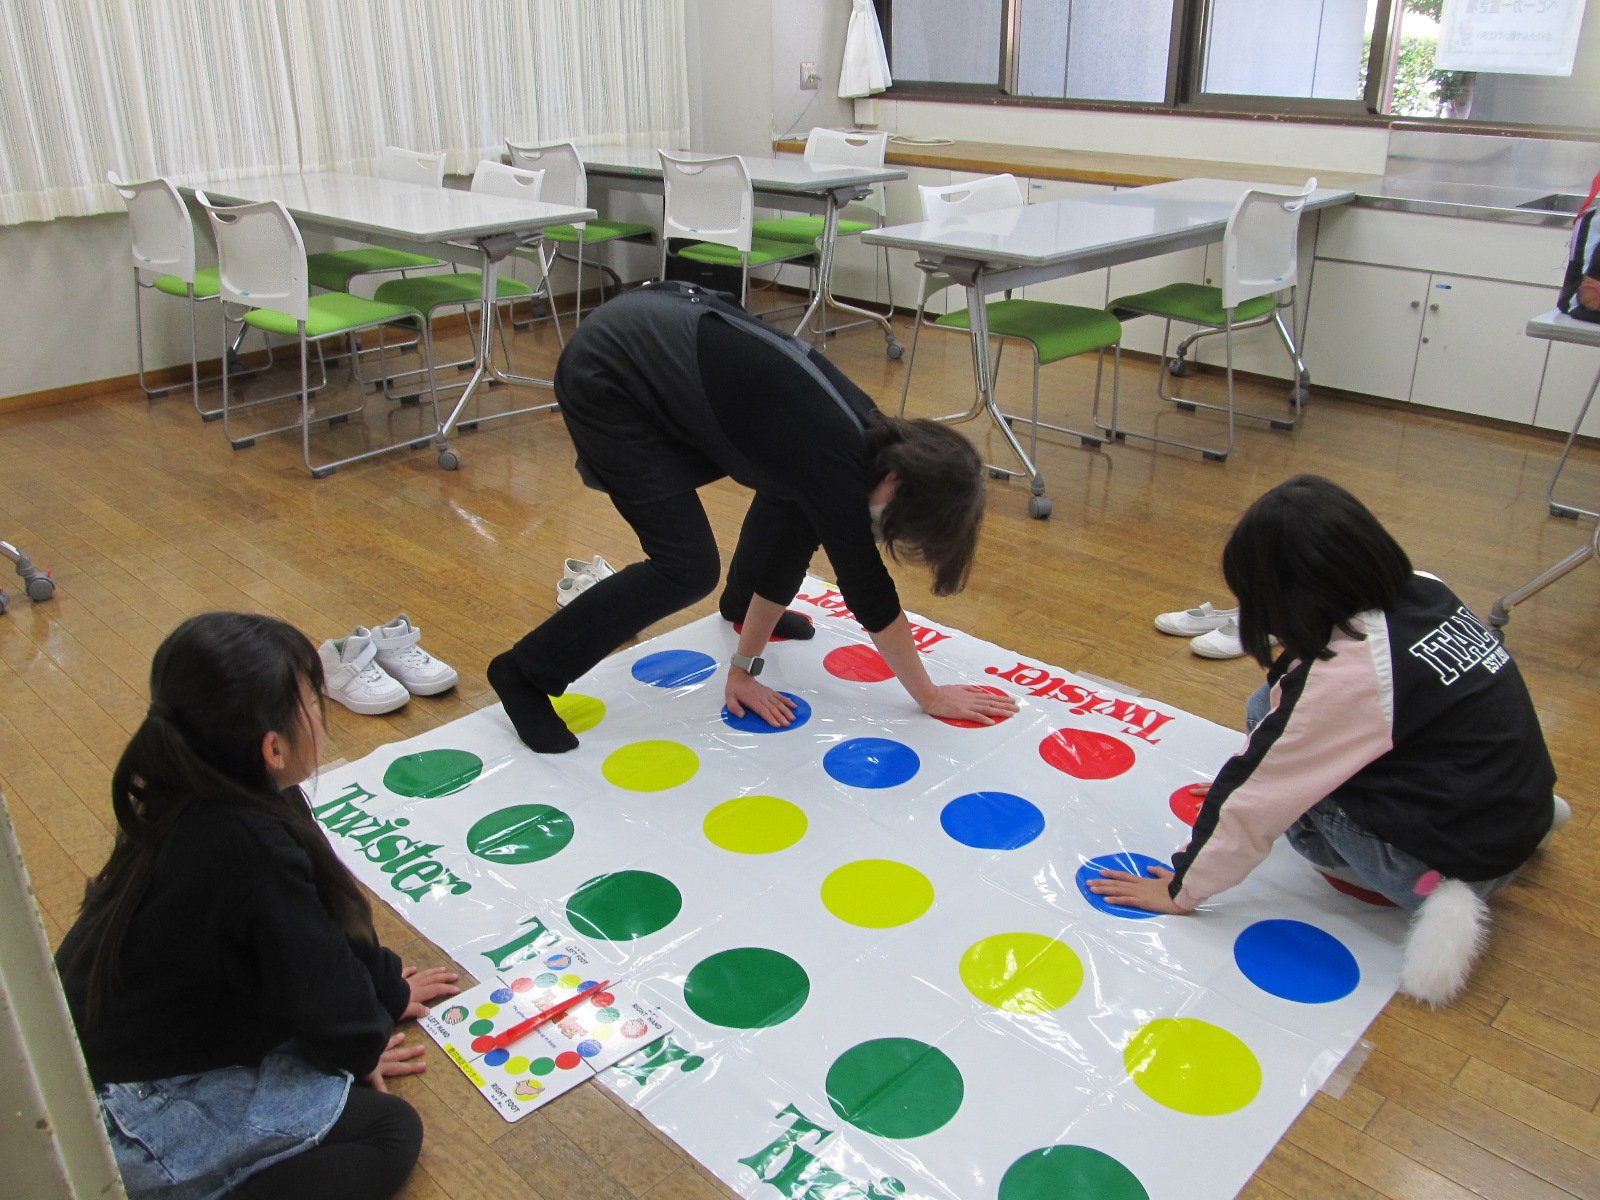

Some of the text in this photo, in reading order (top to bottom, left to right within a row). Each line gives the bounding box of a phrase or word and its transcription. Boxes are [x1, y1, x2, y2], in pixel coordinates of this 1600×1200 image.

[984, 662, 1176, 745] Twister
[314, 782, 472, 903] Twister
[565, 945, 577, 955] LEFT
[575, 954, 589, 965] FOOT
[427, 1015, 440, 1027] LEFT
[436, 1025, 450, 1038] HAND
[632, 1003, 662, 1030] RIGHT HAND
[491, 1083, 520, 1112] RIGHT FOOT
